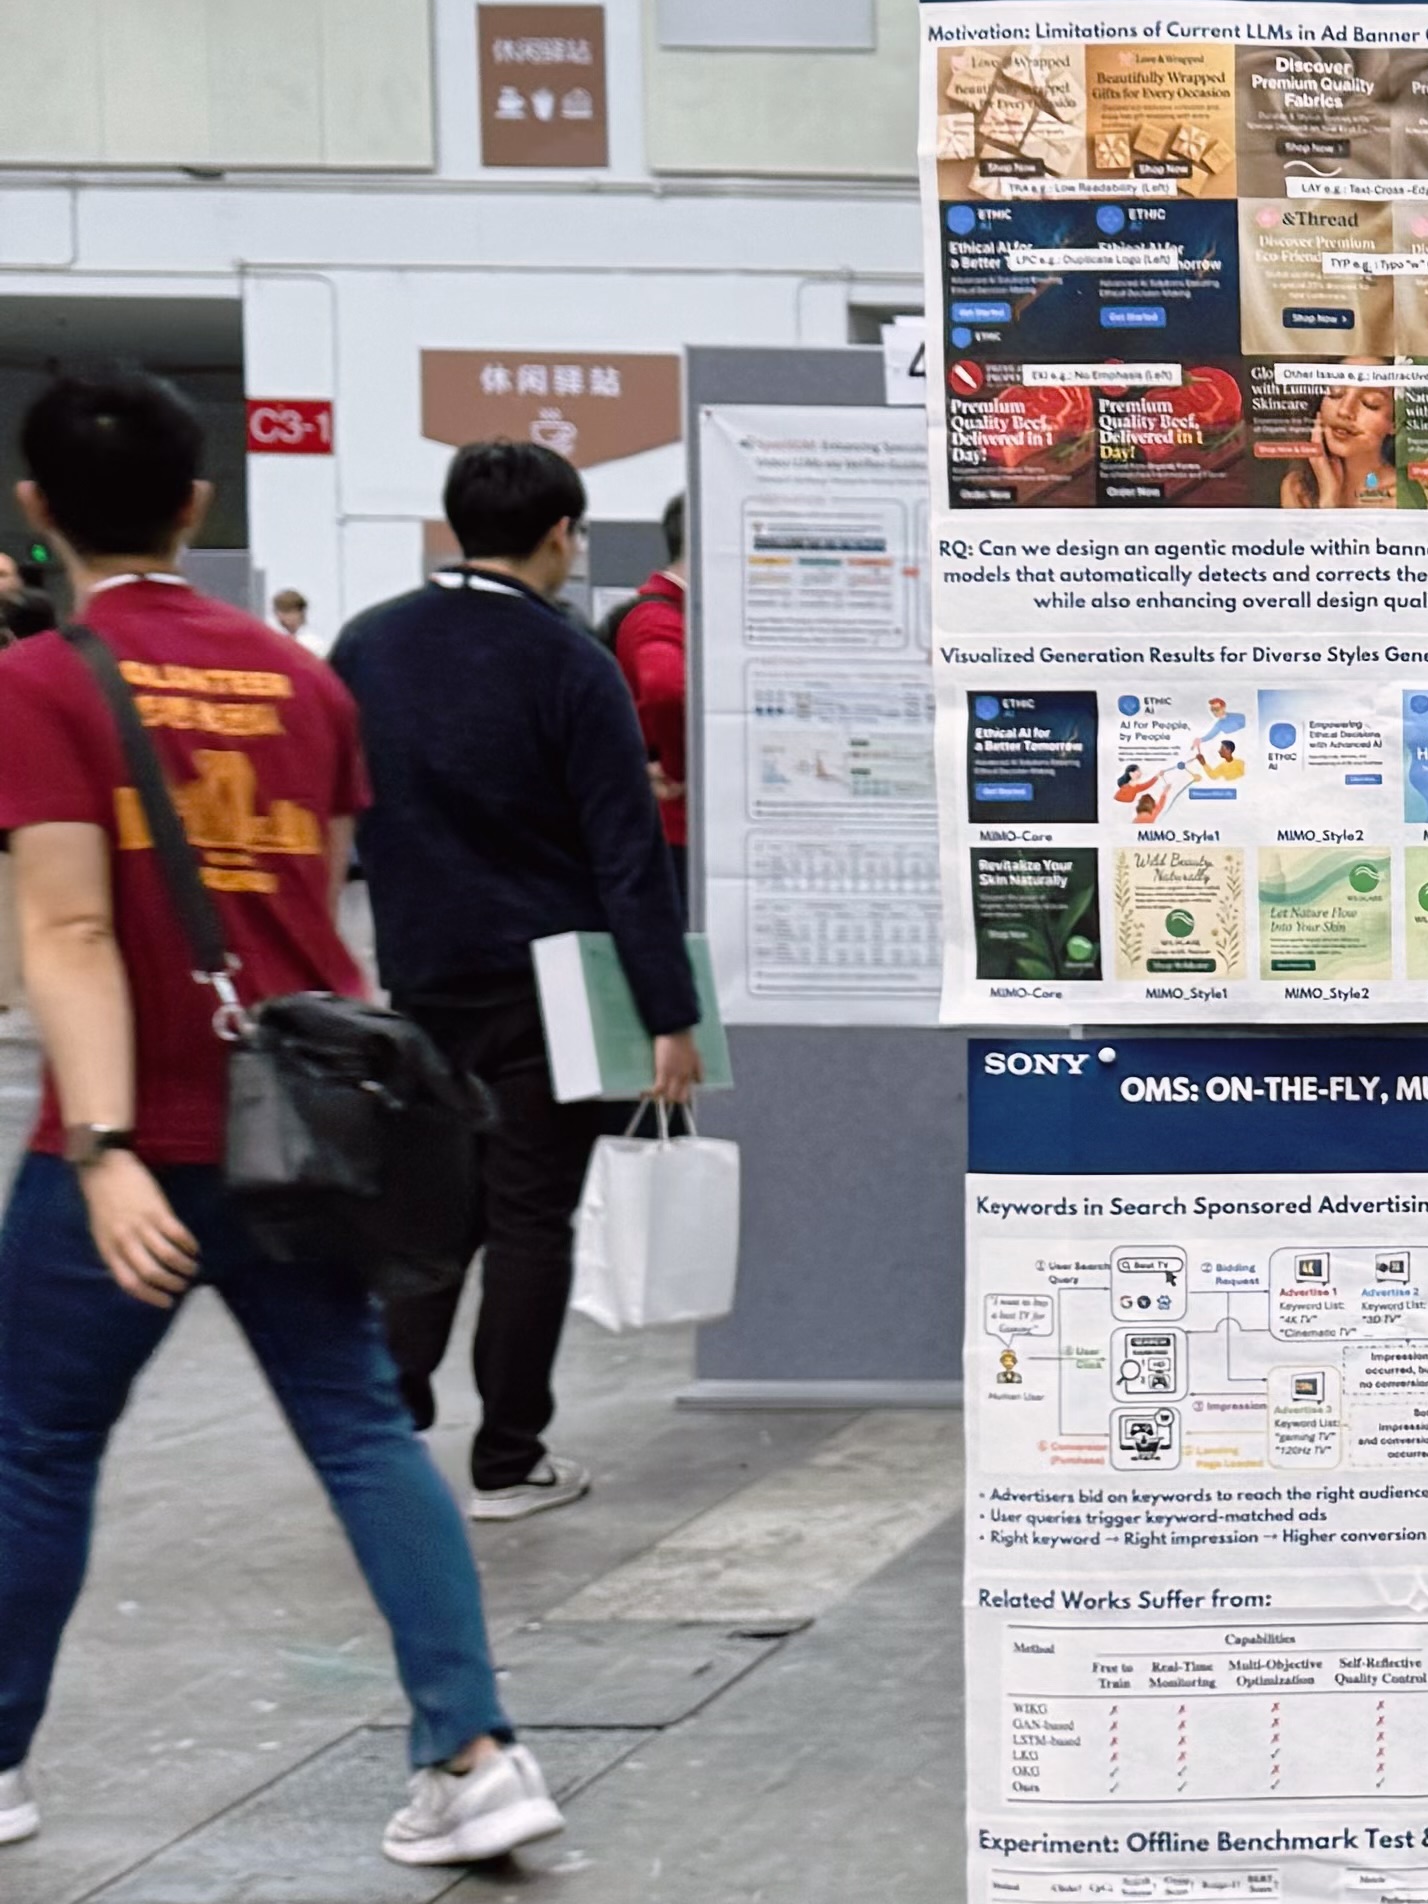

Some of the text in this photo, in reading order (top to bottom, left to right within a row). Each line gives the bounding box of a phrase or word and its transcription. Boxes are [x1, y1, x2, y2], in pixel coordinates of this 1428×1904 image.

[926, 22, 1031, 42] Motivation:
[1034, 22, 1140, 40] Limitations
[1142, 21, 1162, 38] of
[1165, 22, 1242, 40] Current
[1245, 23, 1294, 41] LLMs
[1296, 24, 1316, 41] in
[1320, 25, 1347, 41] Ad
[1352, 25, 1420, 43] Banner
[1276, 57, 1351, 75] Discover
[1252, 75, 1374, 96] Premium Quality
[1284, 93, 1344, 110] Fabrics
[249, 407, 333, 446] C3-1
[938, 539, 974, 560] RQ:
[978, 538, 1016, 556] Can
[1020, 544, 1050, 556] we
[1055, 538, 1119, 560] design
[1123, 544, 1149, 555] an
[1154, 538, 1226, 560] agentic
[1231, 538, 1305, 556] module
[1309, 538, 1370, 556] within
[939, 645, 1034, 663] Visualized
[1038, 646, 1144, 663] Generation
[1148, 645, 1215, 663] Results
[1219, 645, 1247, 662] for
[1252, 646, 1322, 662] Diverse
[1326, 644, 1379, 666] Styles
[983, 1051, 1090, 1076] SONY
[1120, 1076, 1199, 1102] OMS:
[1205, 1075, 1388, 1105] ON-THE-FLY,
[976, 1195, 1078, 1220] Keywords
[1082, 1196, 1103, 1216] in
[1108, 1195, 1186, 1215] Search
[1192, 1194, 1312, 1220] Sponsored
[978, 1587, 1272, 1610] Related Works Suffer from:
[978, 1828, 1119, 1856] Experiment:
[1125, 1830, 1210, 1853] Offline
[1216, 1826, 1358, 1852] Benchmark
[1364, 1827, 1414, 1849] Test
